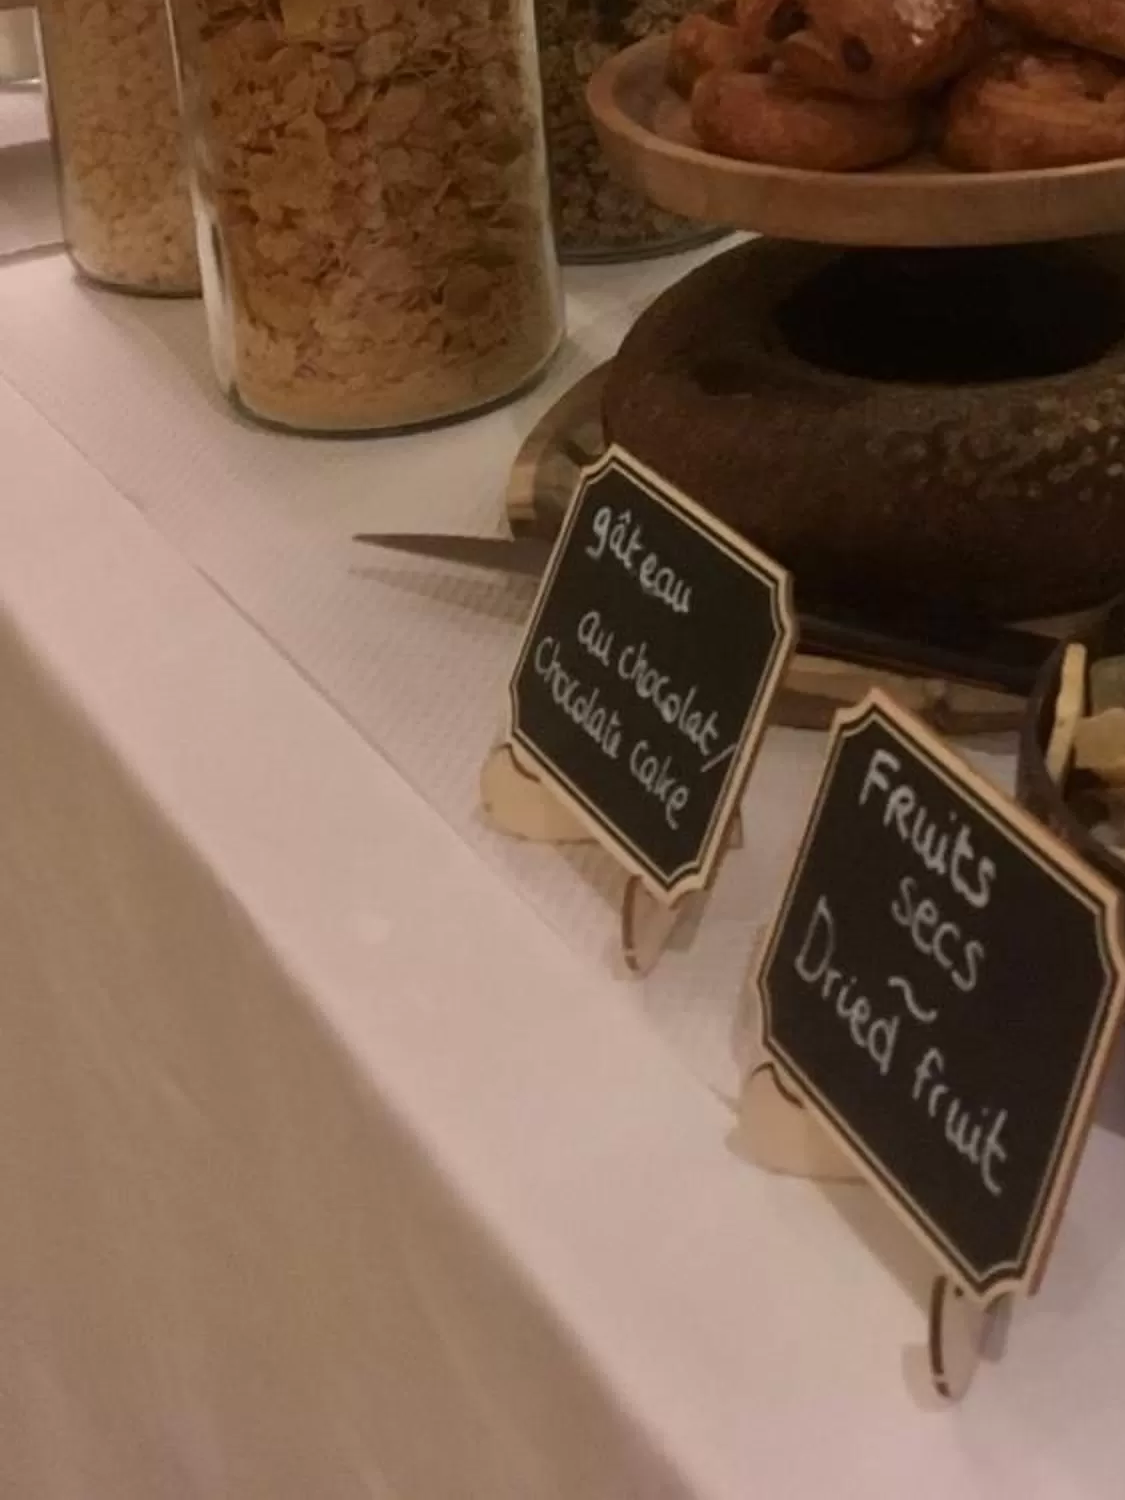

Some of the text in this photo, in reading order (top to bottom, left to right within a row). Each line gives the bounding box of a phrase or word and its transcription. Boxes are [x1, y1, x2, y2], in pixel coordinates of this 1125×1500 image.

[585, 506, 692, 613] gâteau
[578, 611, 615, 667] au
[891, 876, 984, 991] secs
[794, 895, 1007, 1196] Dried fruit
